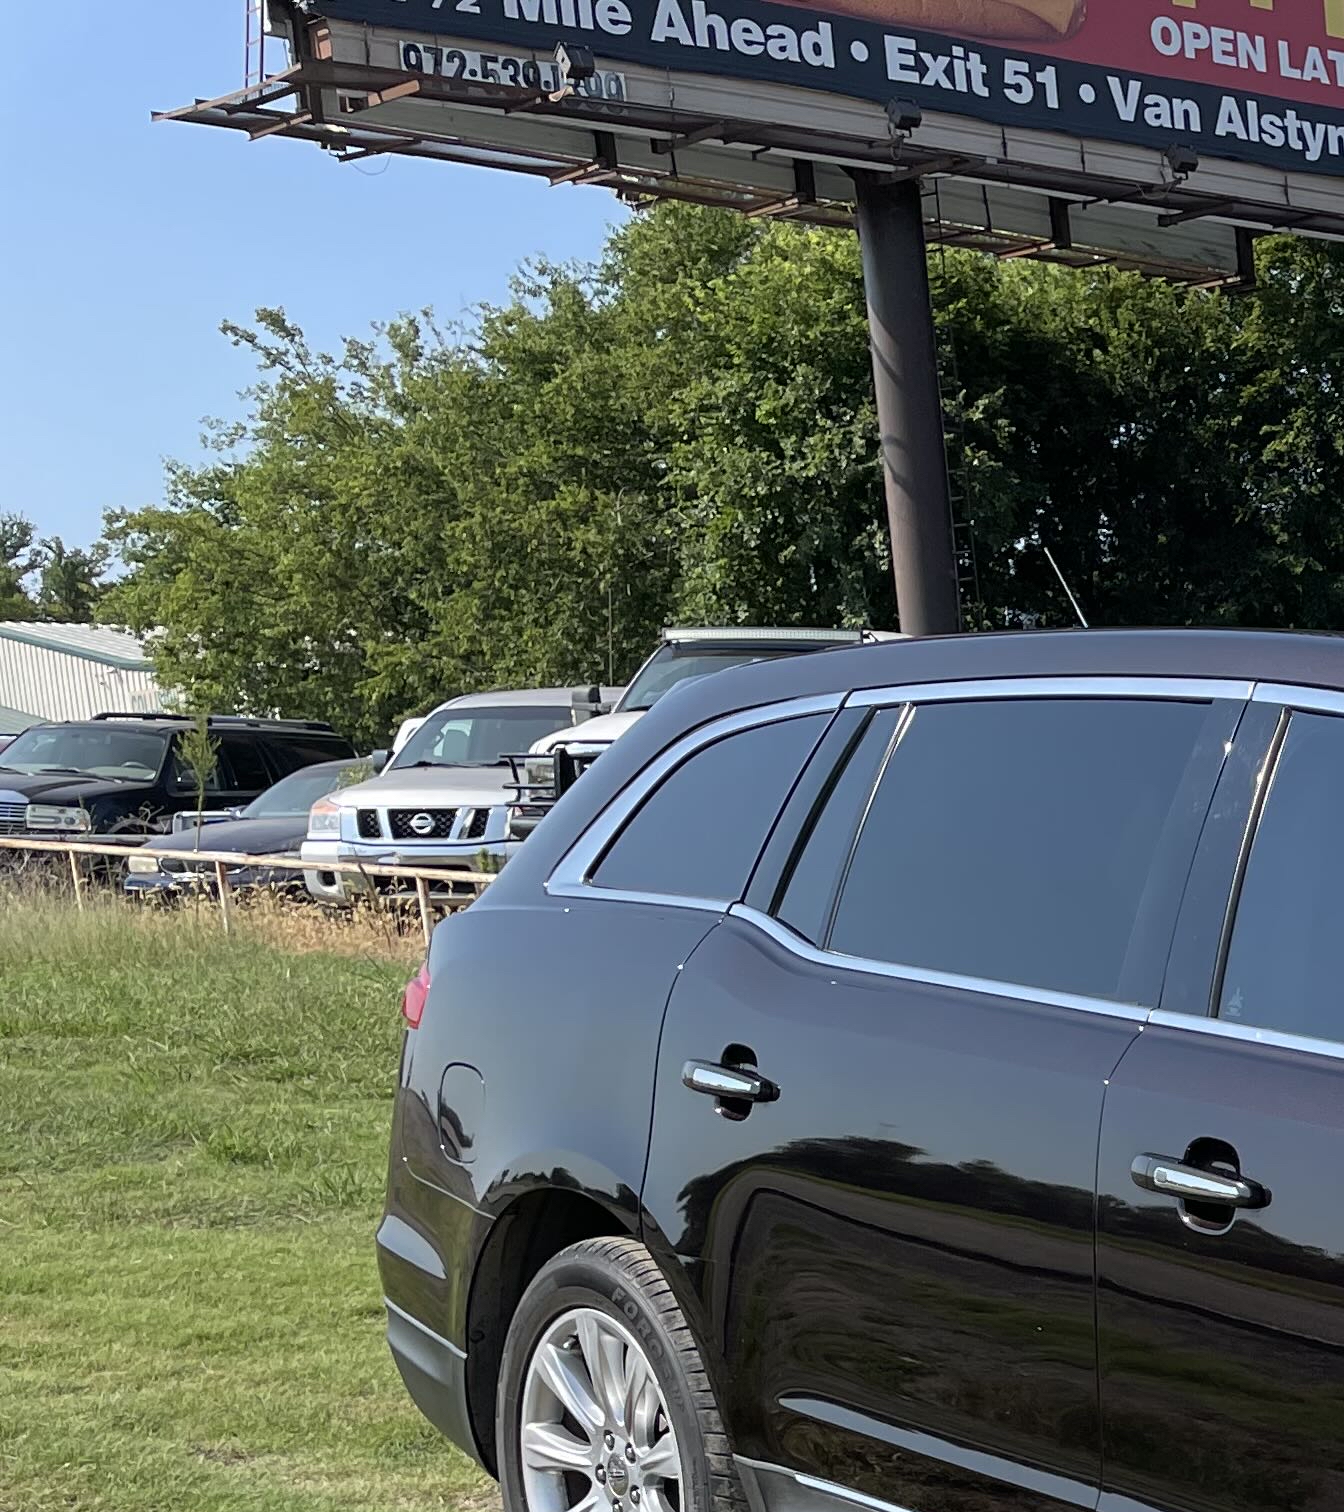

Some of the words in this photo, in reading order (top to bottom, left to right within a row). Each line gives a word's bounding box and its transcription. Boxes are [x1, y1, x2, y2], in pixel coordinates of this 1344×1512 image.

[651, 0, 836, 68] Ahead
[884, 34, 990, 97] Exit
[1003, 58, 1059, 109] 51
[1106, 76, 1201, 132] Van
[1150, 16, 1267, 73] OPEN
